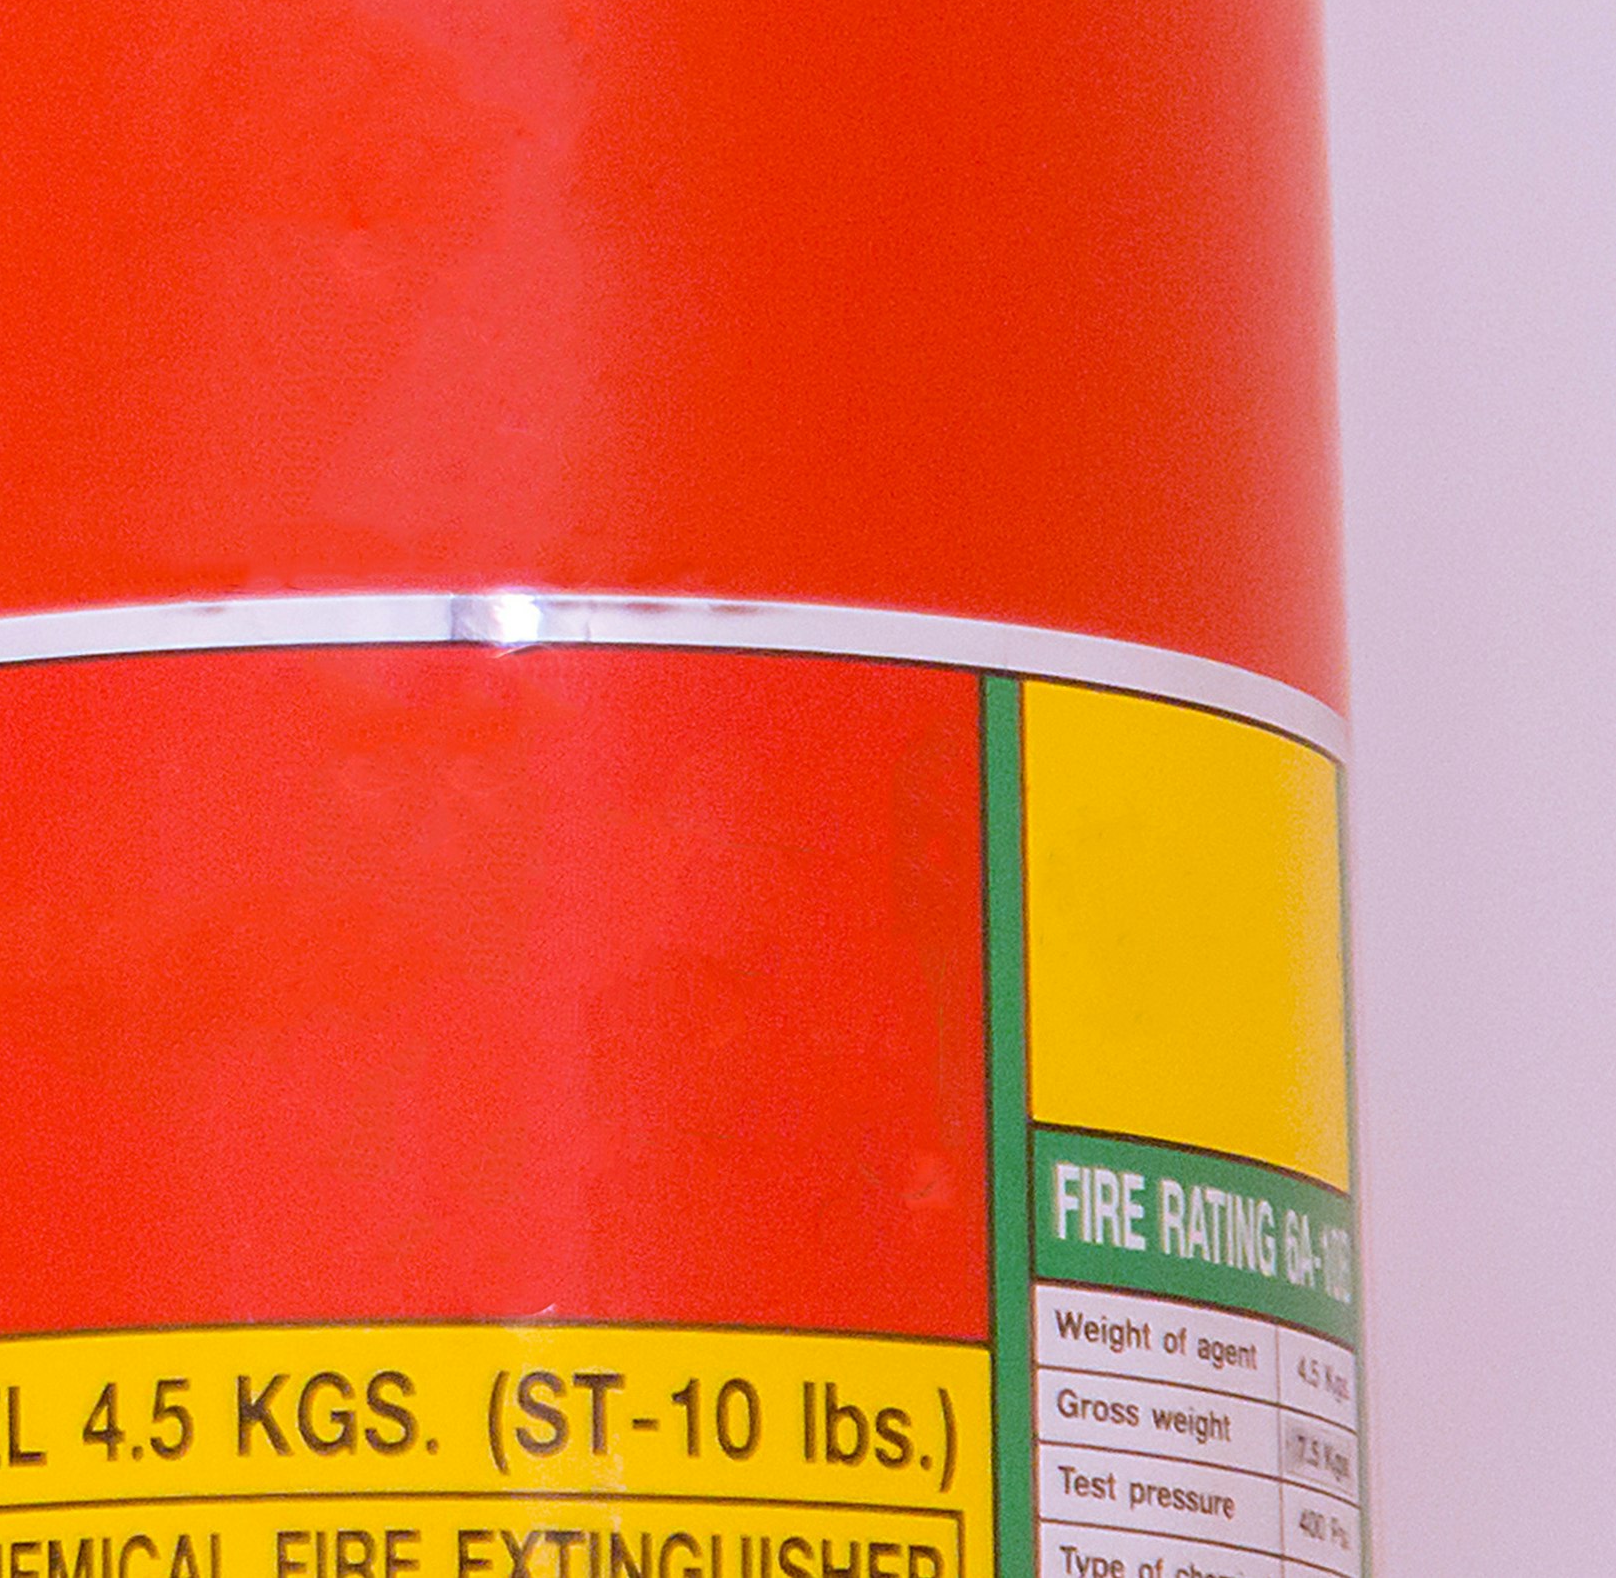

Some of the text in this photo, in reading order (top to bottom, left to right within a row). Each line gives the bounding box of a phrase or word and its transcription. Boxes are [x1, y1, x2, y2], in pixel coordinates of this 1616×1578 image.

[1054, 1162, 1147, 1252] FIRE
[1158, 1178, 1277, 1278] RATING
[1054, 1308, 1151, 1354] Weight
[1163, 1327, 1187, 1356] of
[1197, 1336, 1258, 1370] agent
[82, 1379, 195, 1462] 4.5
[236, 1370, 441, 1458] KGS.
[487, 1369, 764, 1476] (ST-10
[802, 1380, 959, 1493] lbs.)
[1057, 1388, 1140, 1428] Gross
[1151, 1407, 1232, 1445] weight
[1057, 1465, 1117, 1501] Test
[1130, 1480, 1236, 1520] pressure
[1059, 1545, 1125, 1578] Type
